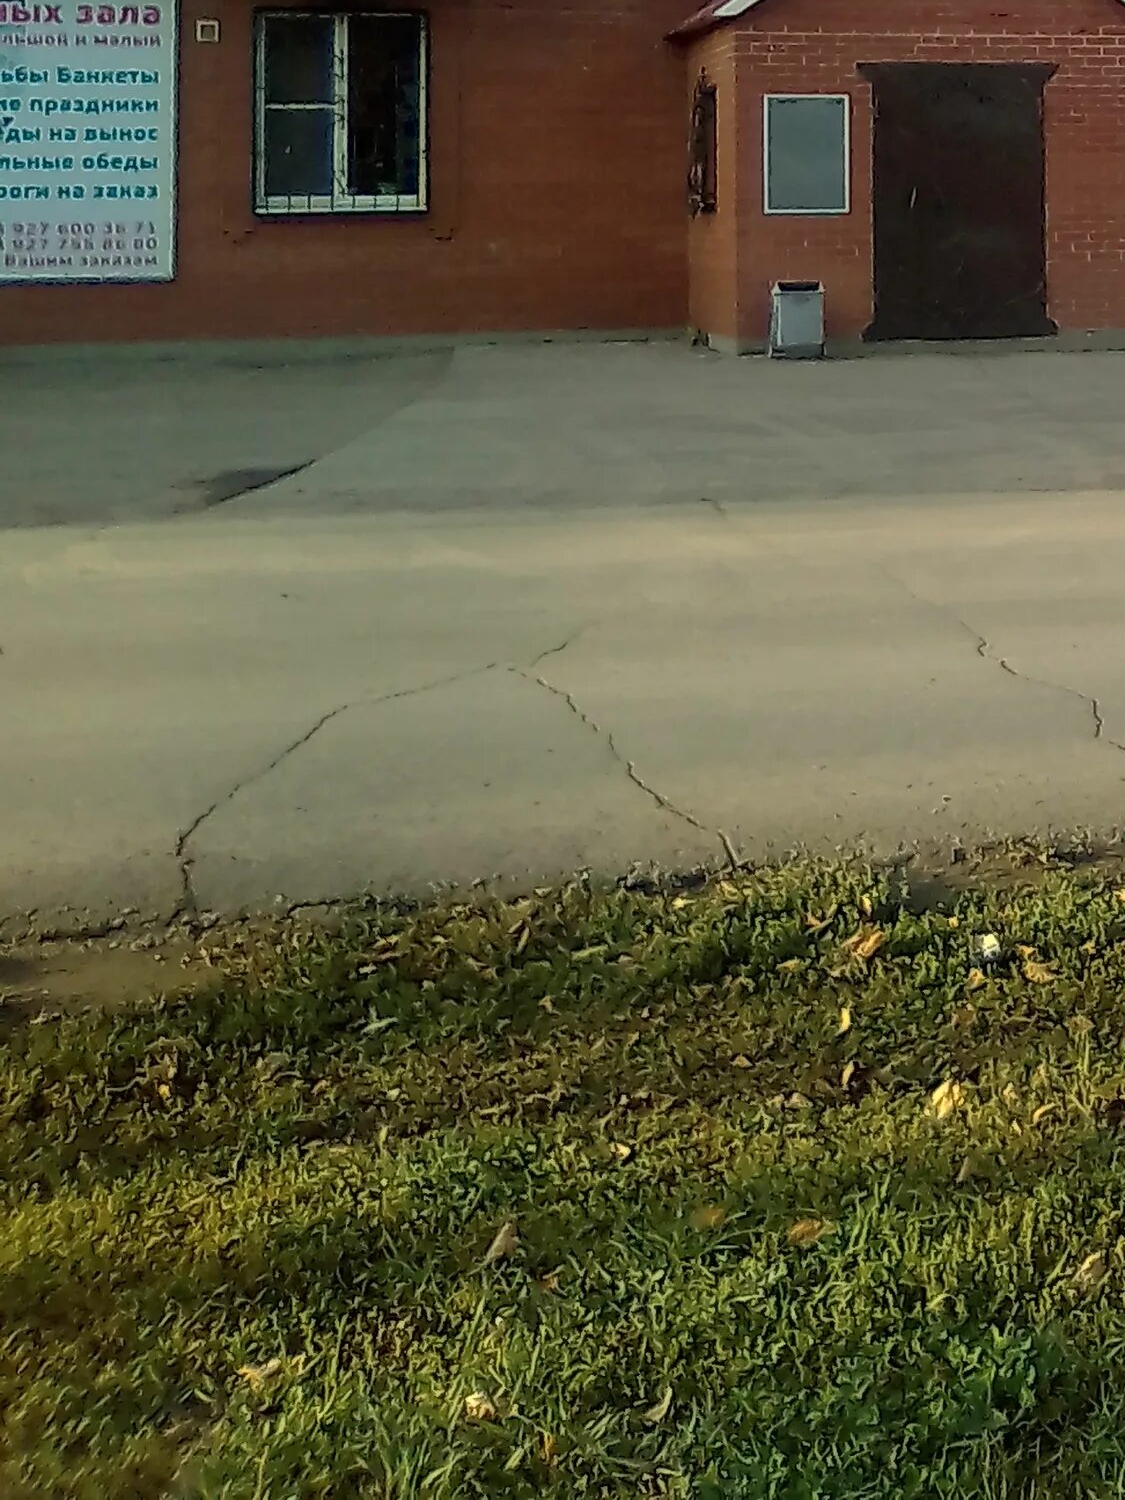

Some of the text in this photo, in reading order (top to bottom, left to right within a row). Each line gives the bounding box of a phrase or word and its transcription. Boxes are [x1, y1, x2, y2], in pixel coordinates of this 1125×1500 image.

[76, 4, 161, 26] зала
[75, 34, 87, 47] и
[94, 34, 161, 48] малый
[57, 66, 159, 85] Банкеты
[30, 99, 158, 116] праздники
[49, 128, 77, 141] на
[84, 128, 158, 142] вынос
[82, 152, 158, 172] обеды
[58, 186, 85, 199] на
[93, 185, 158, 199] заказ
